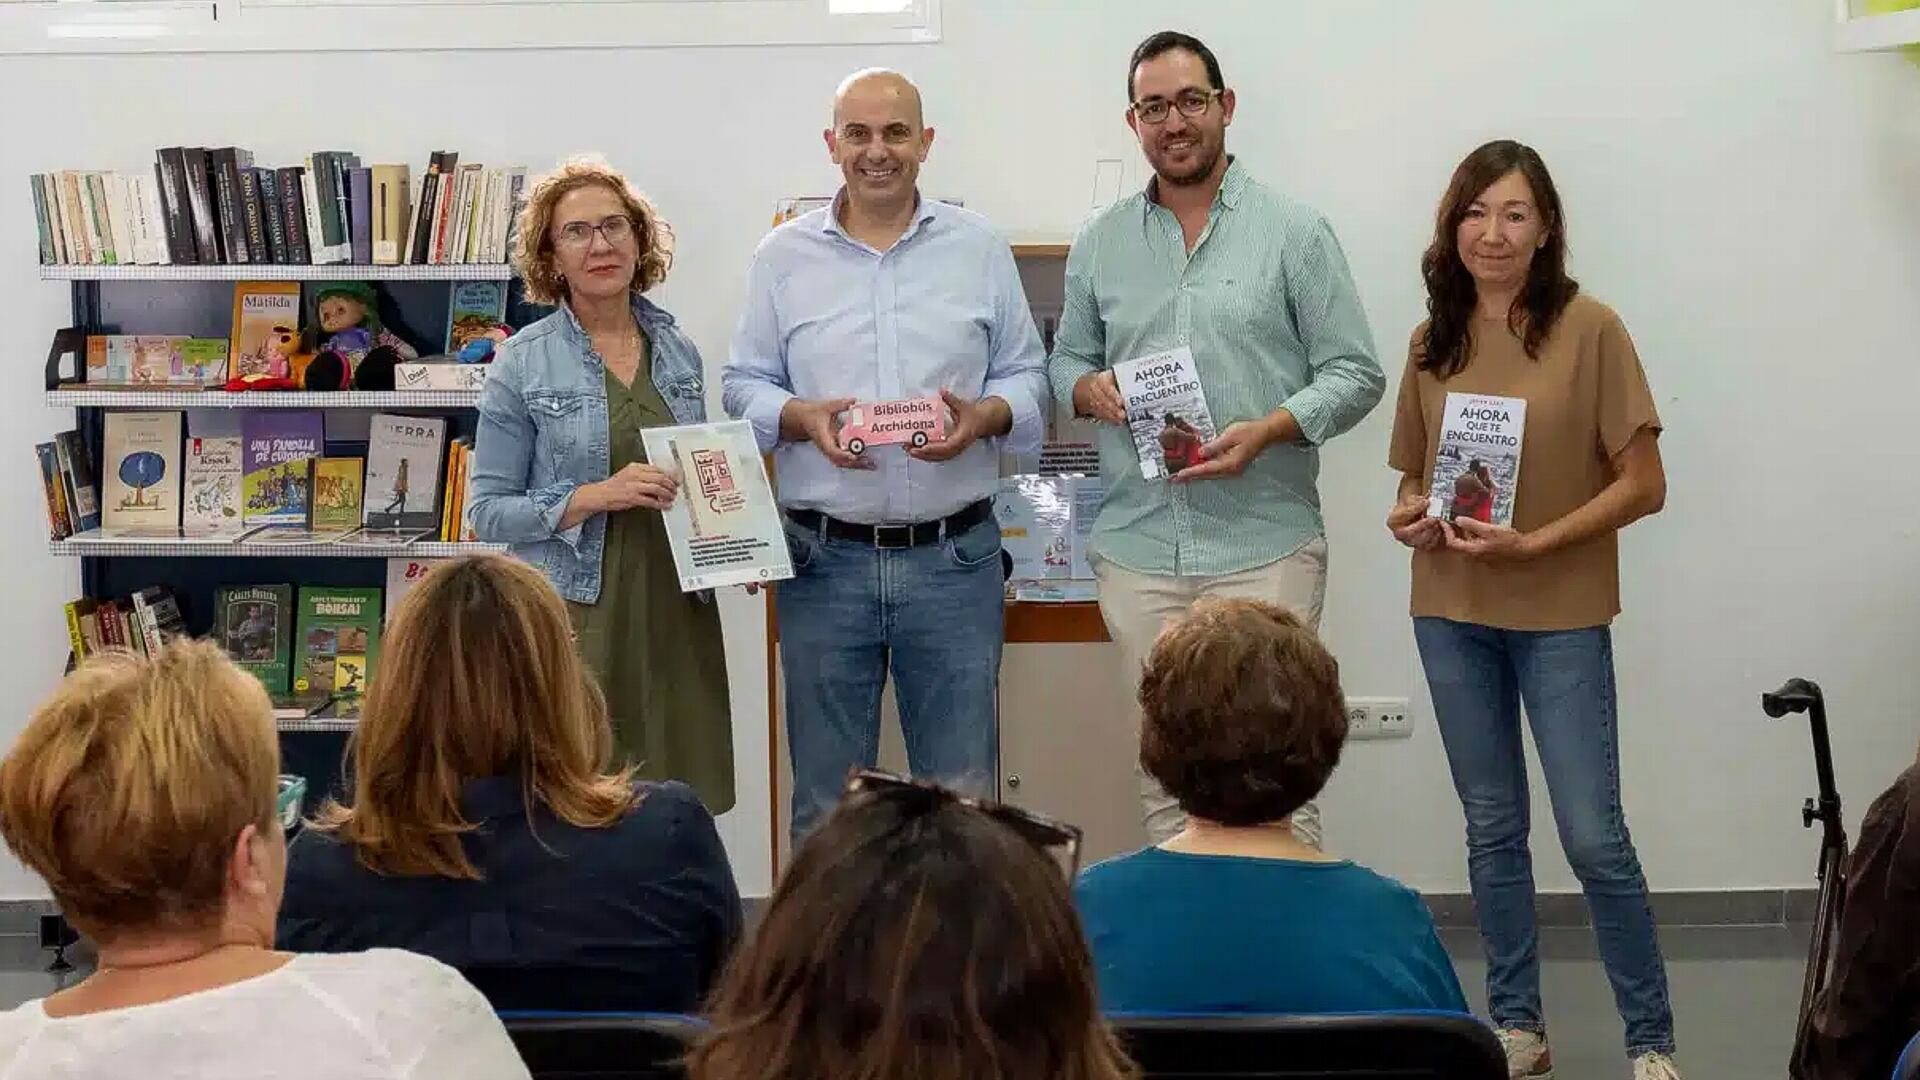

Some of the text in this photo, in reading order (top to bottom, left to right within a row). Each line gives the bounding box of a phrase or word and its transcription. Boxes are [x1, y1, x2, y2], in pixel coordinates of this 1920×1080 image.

[244, 295, 290, 308] Matilda
[1135, 361, 1184, 382] AHORA
[1145, 374, 1178, 390] QUE TE
[1129, 380, 1199, 406] ENCUENTRO
[873, 401, 933, 416] Bibliobús
[1460, 407, 1511, 423] AHORA
[871, 419, 935, 433] Archidona
[1466, 420, 1502, 433] QUE TE
[1446, 430, 1518, 447] ENCUENTRO
